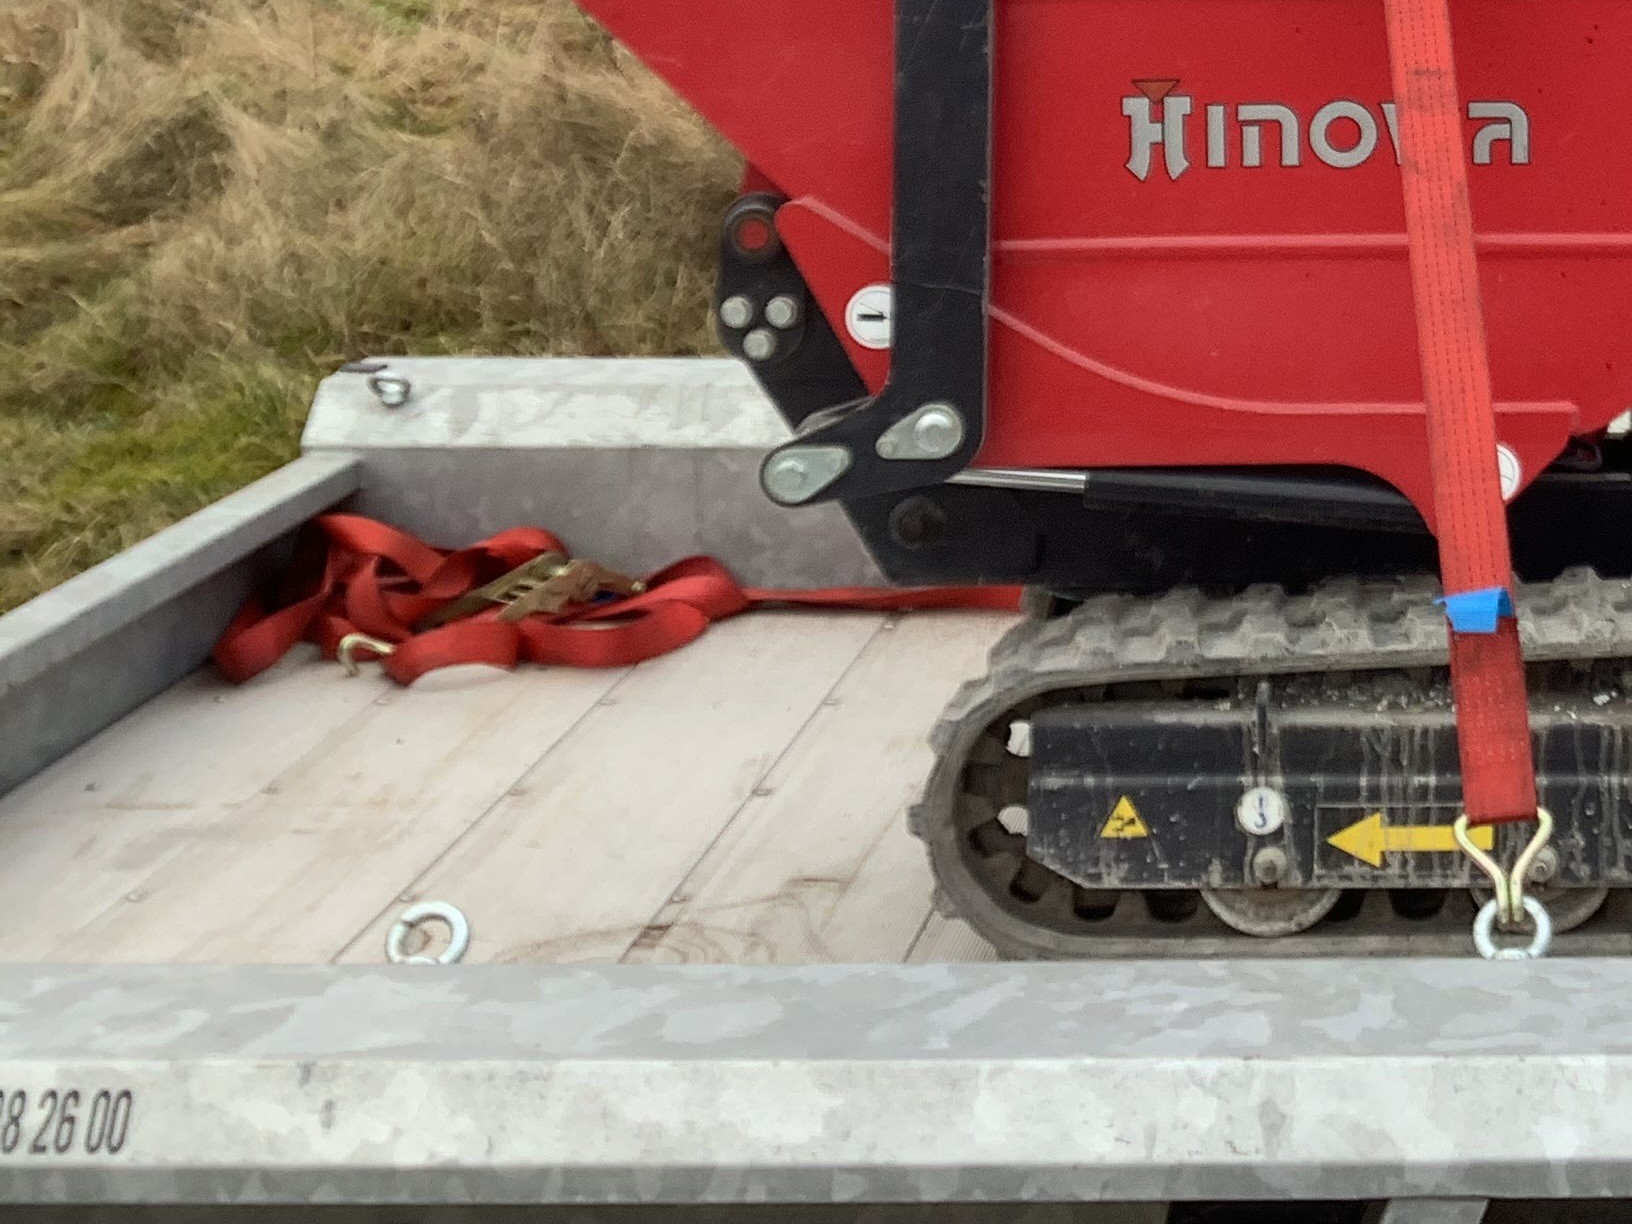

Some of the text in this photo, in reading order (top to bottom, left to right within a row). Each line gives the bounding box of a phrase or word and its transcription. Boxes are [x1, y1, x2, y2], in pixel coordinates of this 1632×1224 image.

[0, 1088, 133, 1155] 8 26 00
